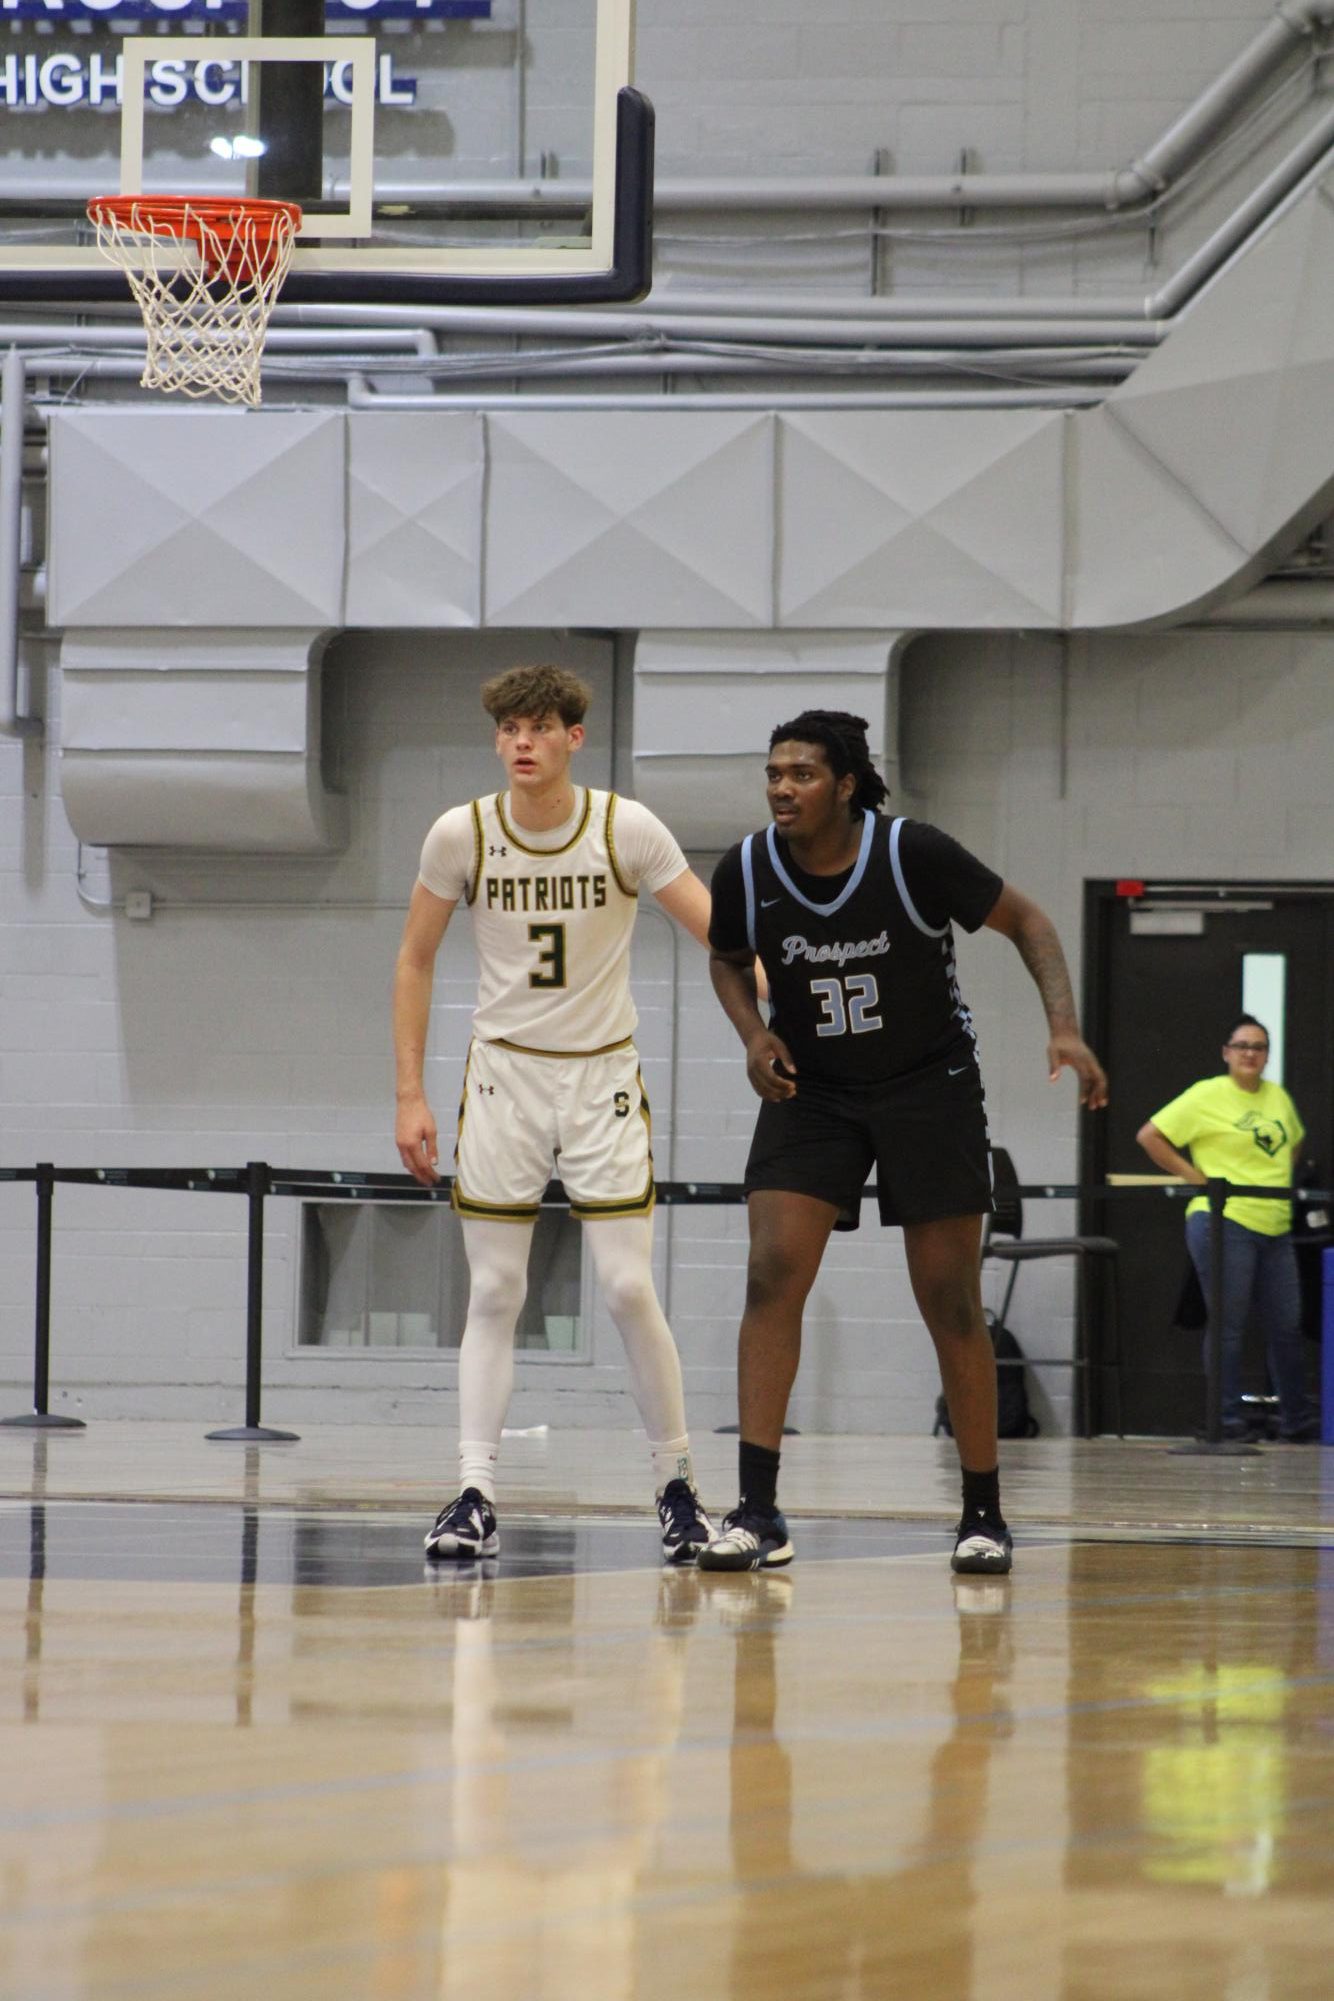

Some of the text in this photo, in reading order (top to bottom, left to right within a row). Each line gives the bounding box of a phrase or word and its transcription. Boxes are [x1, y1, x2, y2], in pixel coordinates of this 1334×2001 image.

[486, 874, 607, 911] PATRIOTS
[528, 922, 567, 988] 3
[781, 930, 891, 967] Prospect
[810, 973, 883, 1037] 32
